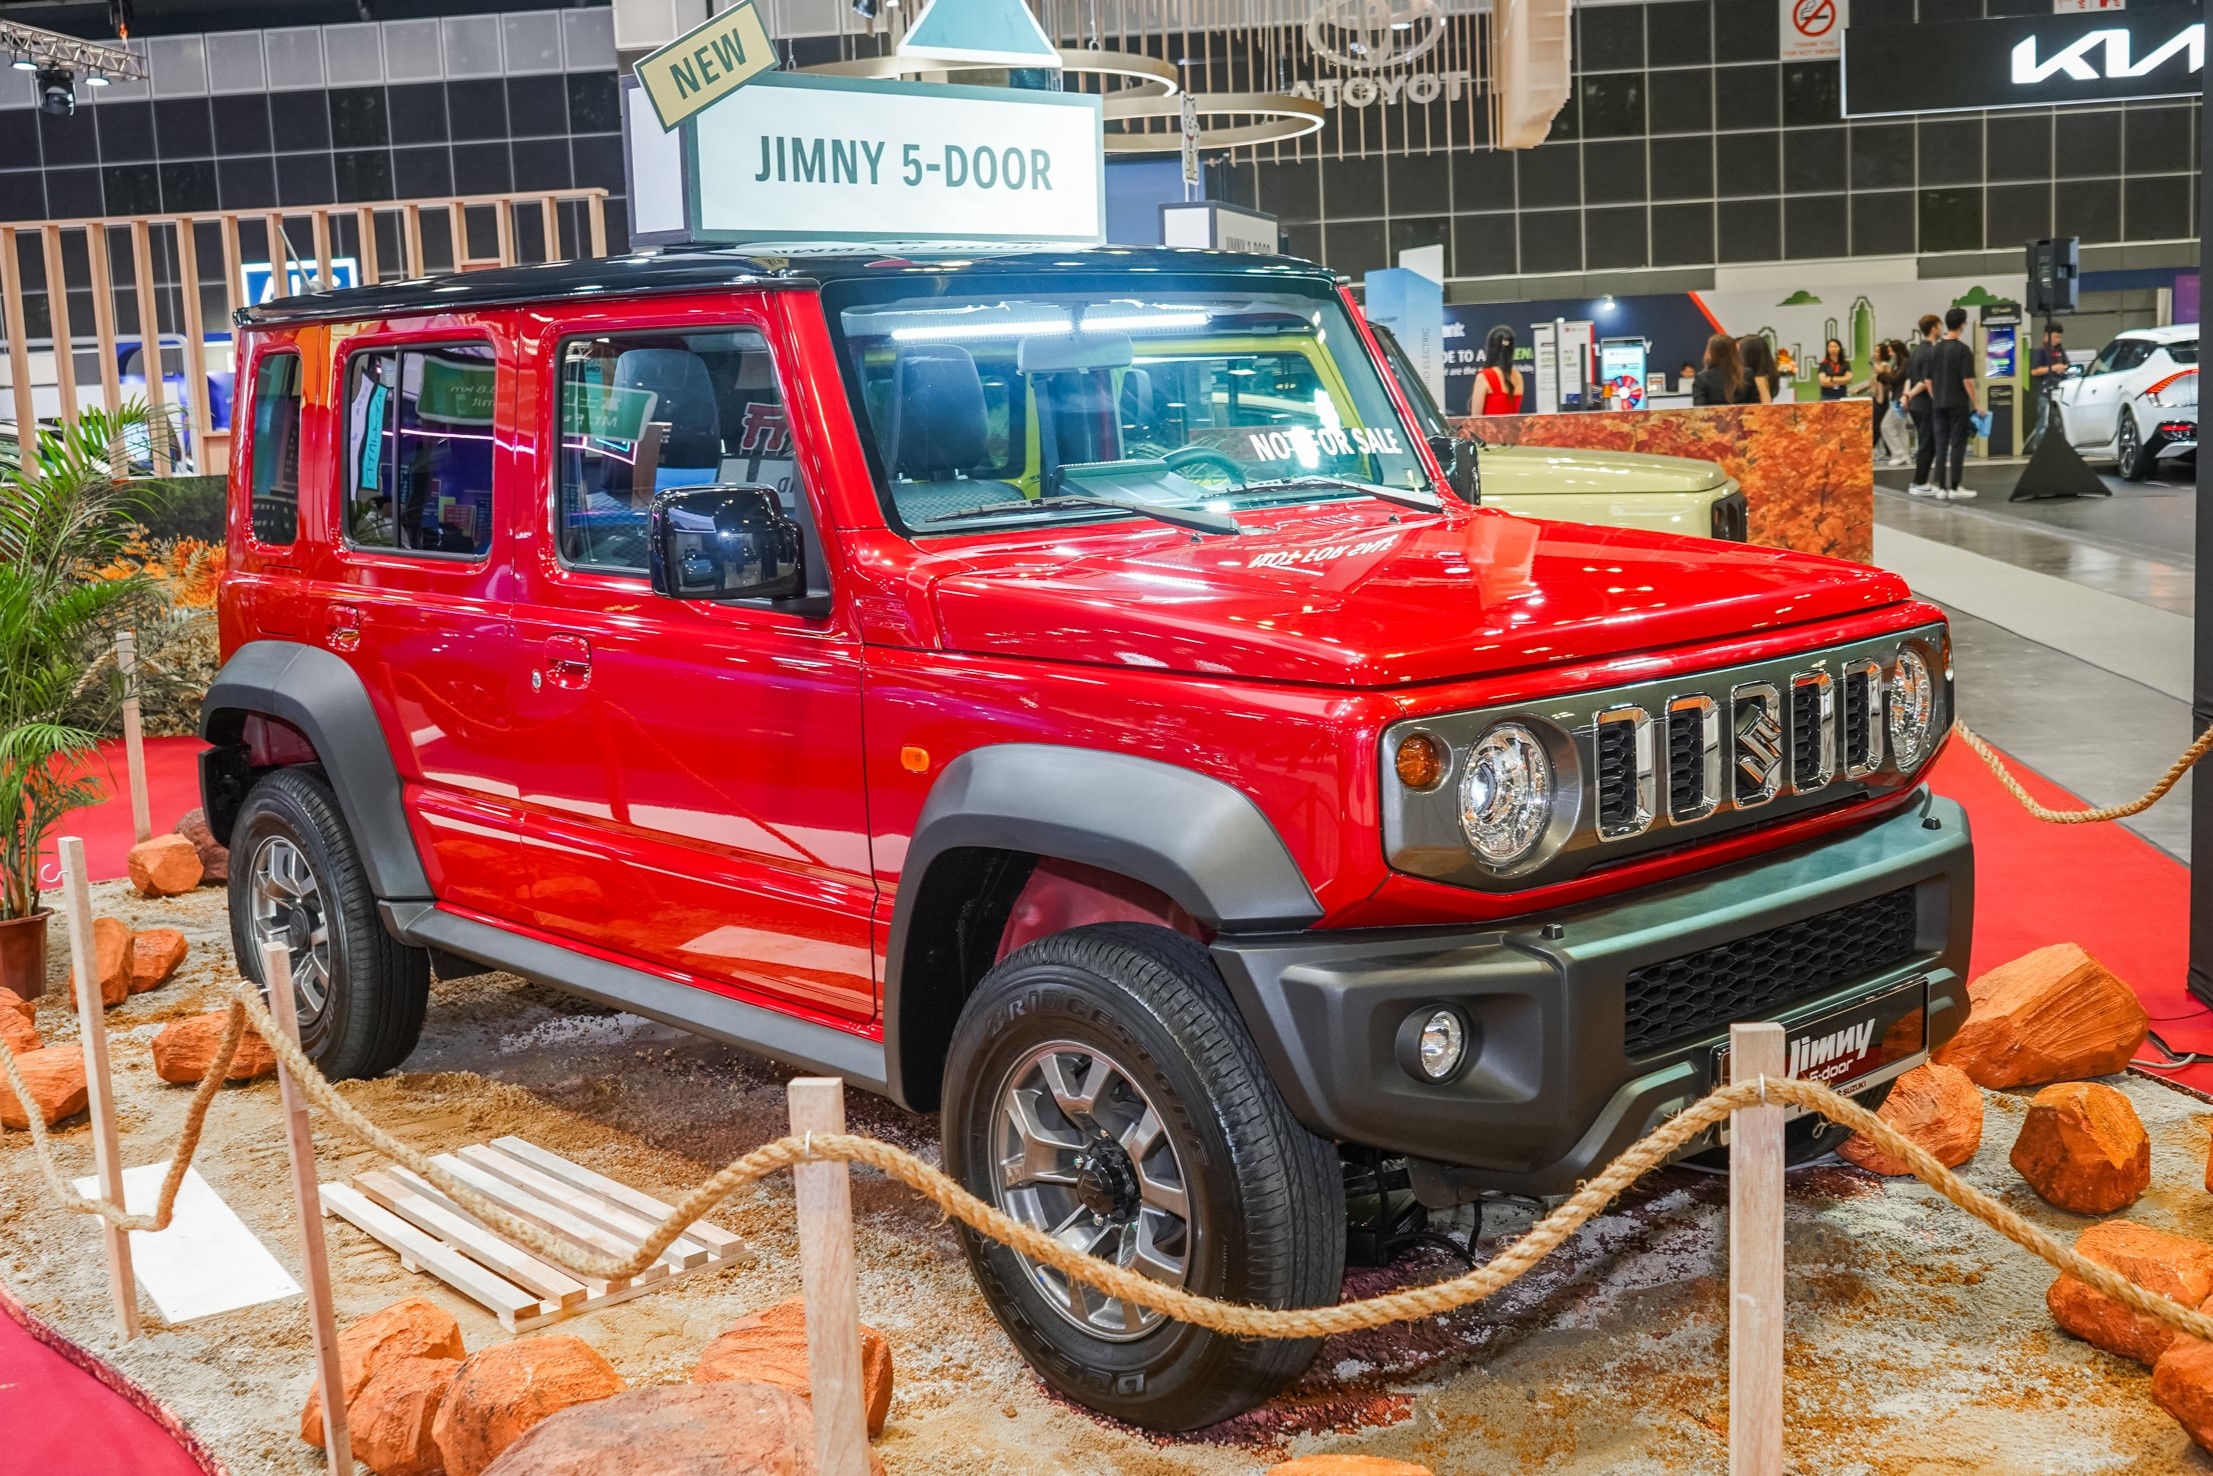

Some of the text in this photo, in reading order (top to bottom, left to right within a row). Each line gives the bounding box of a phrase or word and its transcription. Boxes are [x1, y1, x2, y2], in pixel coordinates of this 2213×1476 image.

[668, 28, 745, 100] NEW
[755, 134, 1052, 191] JIMNY 5-DOOR
[1457, 349, 1474, 363] TO
[1311, 428, 1355, 457] FOR
[1353, 427, 1403, 455] SALE
[1787, 1017, 1876, 1080] Jimny
[985, 988, 1210, 1168] BRIDGESTONE
[1809, 1058, 1854, 1083] 5-door
[1842, 1080, 1867, 1096] SUZUKI
